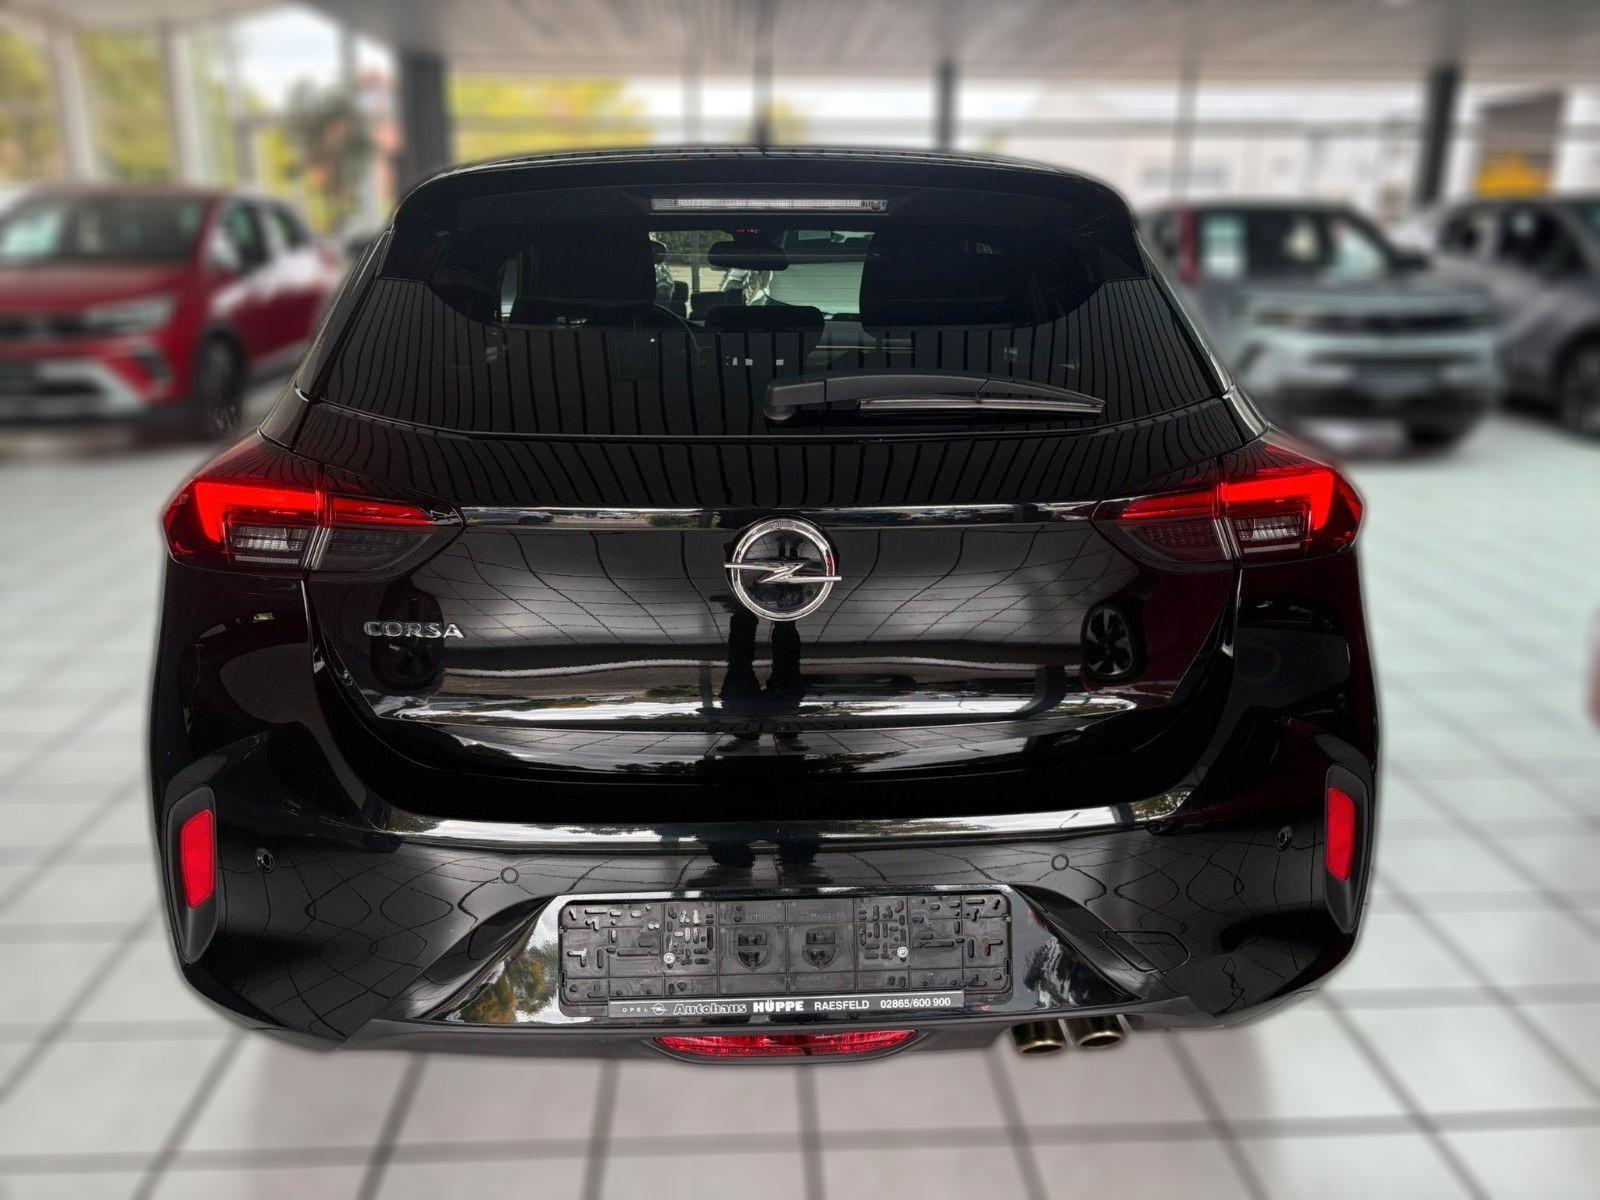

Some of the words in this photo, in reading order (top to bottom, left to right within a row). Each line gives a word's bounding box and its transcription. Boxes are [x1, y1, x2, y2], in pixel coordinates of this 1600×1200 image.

[364, 621, 464, 638] CORSA
[673, 1003, 748, 1015] Autohaus
[752, 999, 805, 1013] HÜPPE
[814, 1000, 870, 1011] RAESFELD
[880, 998, 931, 1009] 02865/600
[932, 997, 951, 1007] 900
